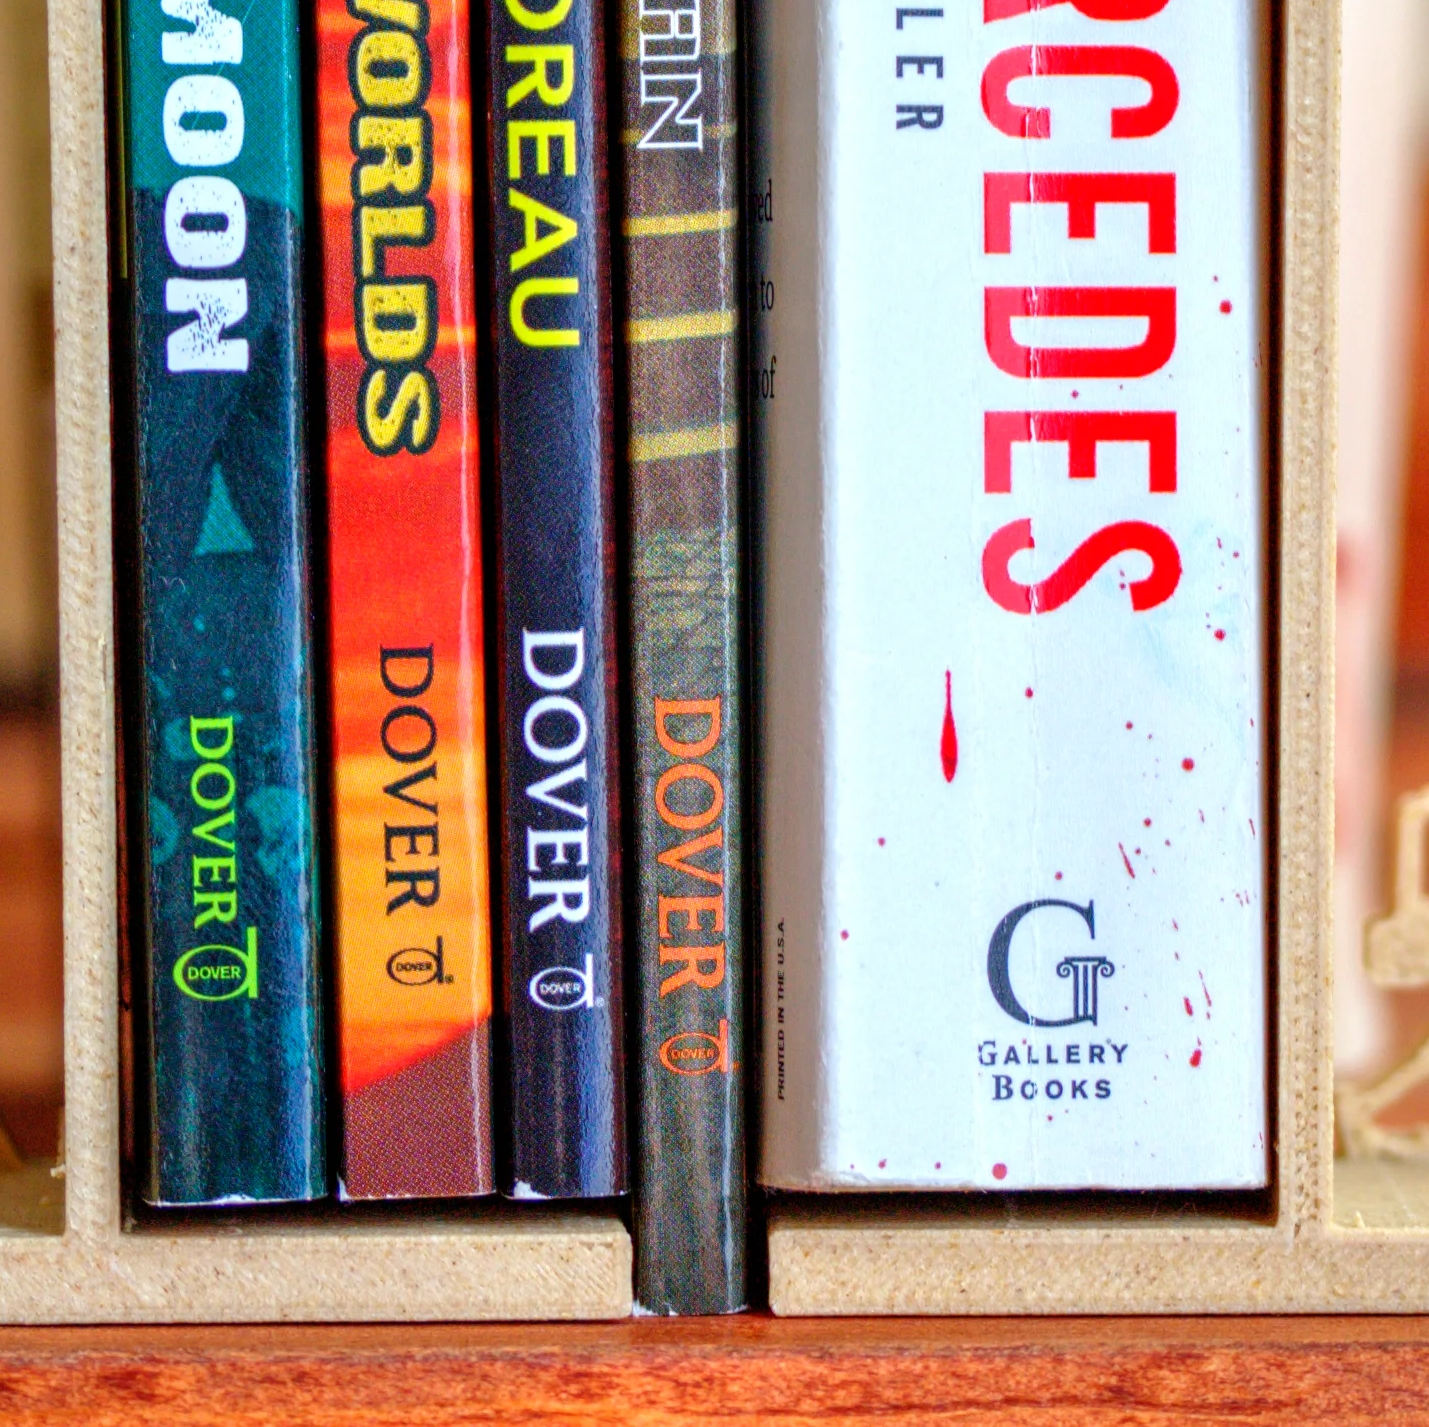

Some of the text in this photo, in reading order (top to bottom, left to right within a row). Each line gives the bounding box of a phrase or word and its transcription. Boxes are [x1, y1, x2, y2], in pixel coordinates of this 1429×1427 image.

[760, 273, 774, 312] to
[761, 355, 777, 400] of
[379, 644, 441, 915] DOVER
[522, 628, 590, 935] DOVER
[189, 715, 237, 929] DOVER
[654, 695, 726, 998] DOVER
[187, 965, 241, 980] DOVER
[396, 961, 433, 973] DOVER
[539, 982, 581, 994] DOVER
[776, 917, 785, 1101] PRINTED IN THE U.S.A.
[977, 1040, 1128, 1067] GALLERY
[991, 1072, 1111, 1101] BOOKS
